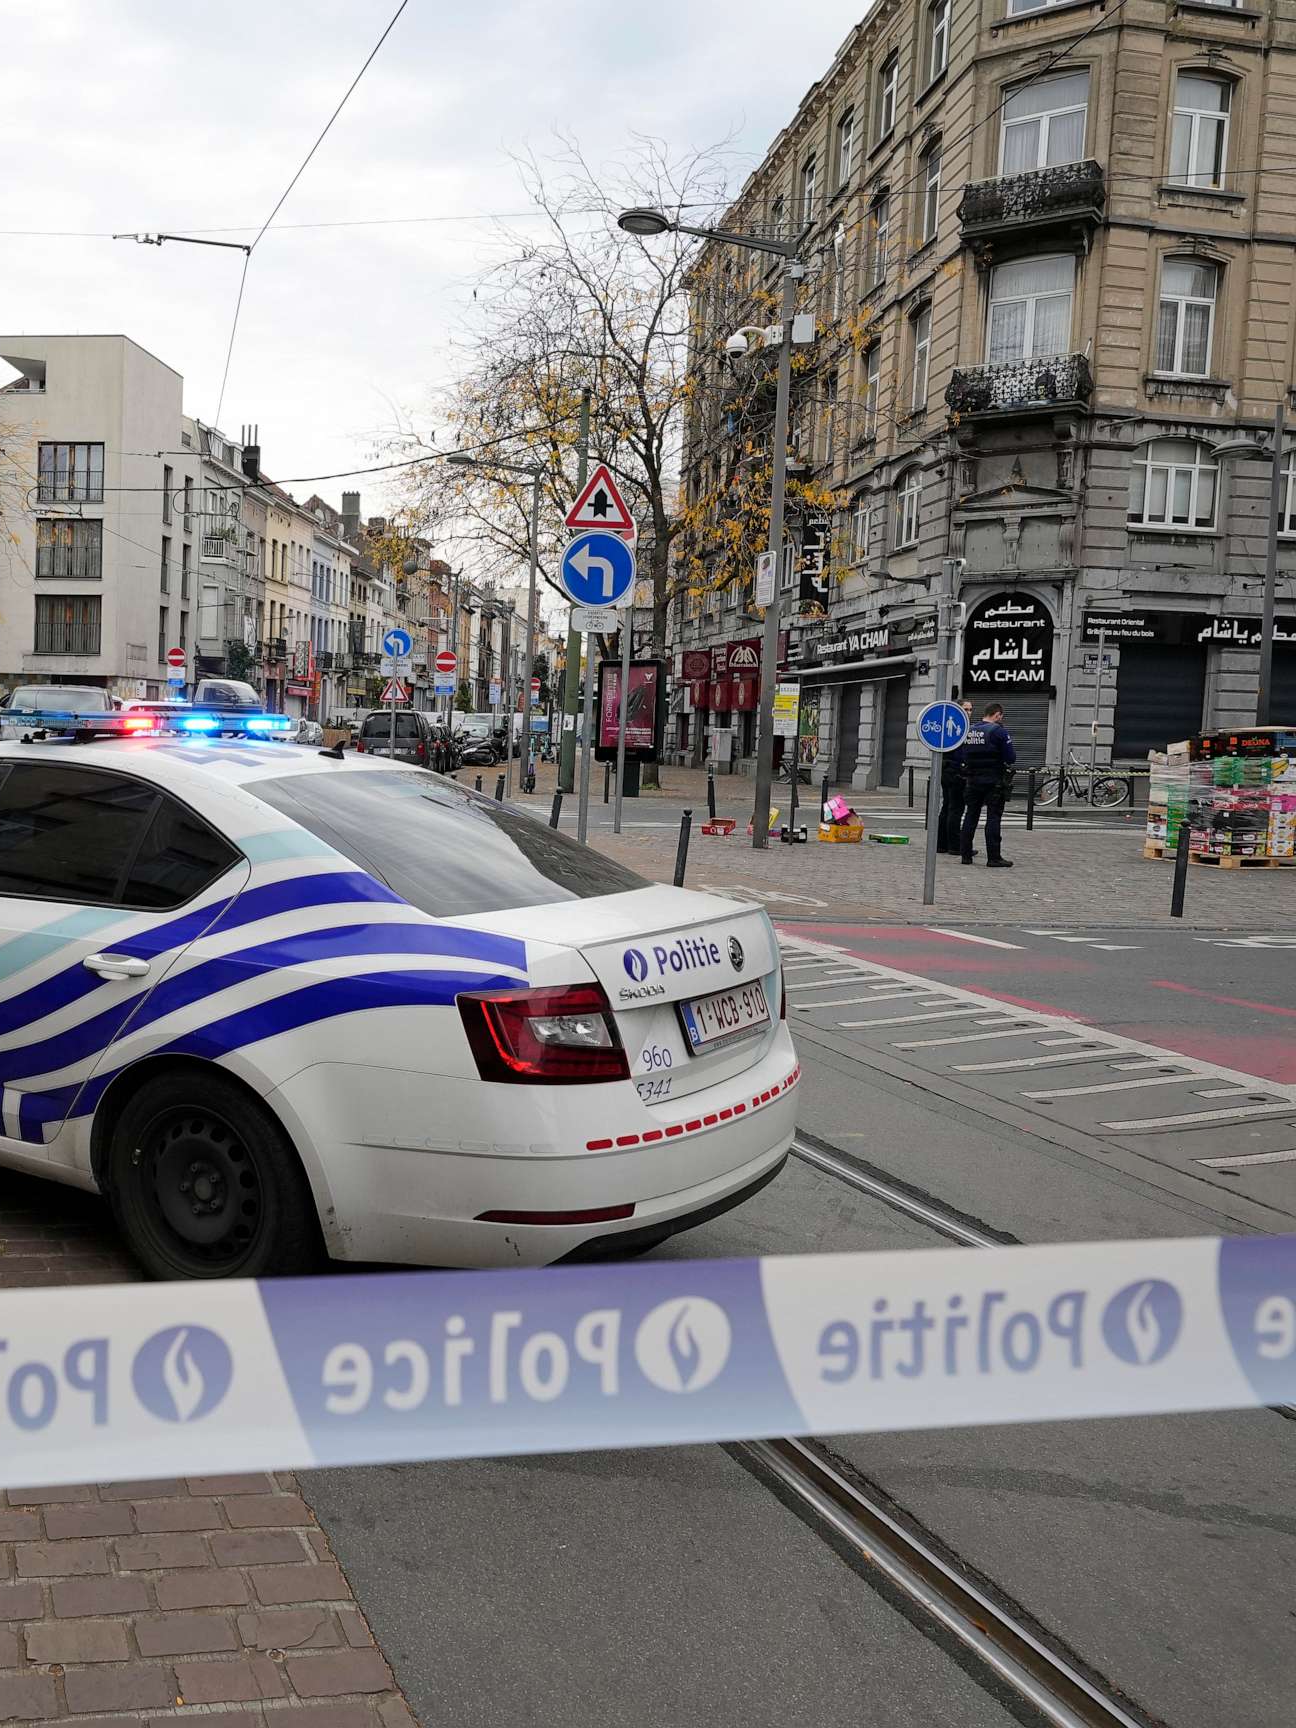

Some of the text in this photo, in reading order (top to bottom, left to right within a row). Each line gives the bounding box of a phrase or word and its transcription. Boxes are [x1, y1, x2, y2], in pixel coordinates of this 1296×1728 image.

[974, 619, 1045, 628] Restaurant
[817, 640, 848, 655] Restaurant
[848, 635, 859, 651] YA
[860, 629, 889, 650] CHAM
[970, 670, 1044, 681] YA CHAM
[967, 730, 984, 738] olice
[652, 936, 721, 976] Politie
[689, 1027, 698, 1041] B
[642, 1045, 672, 1071] 960
